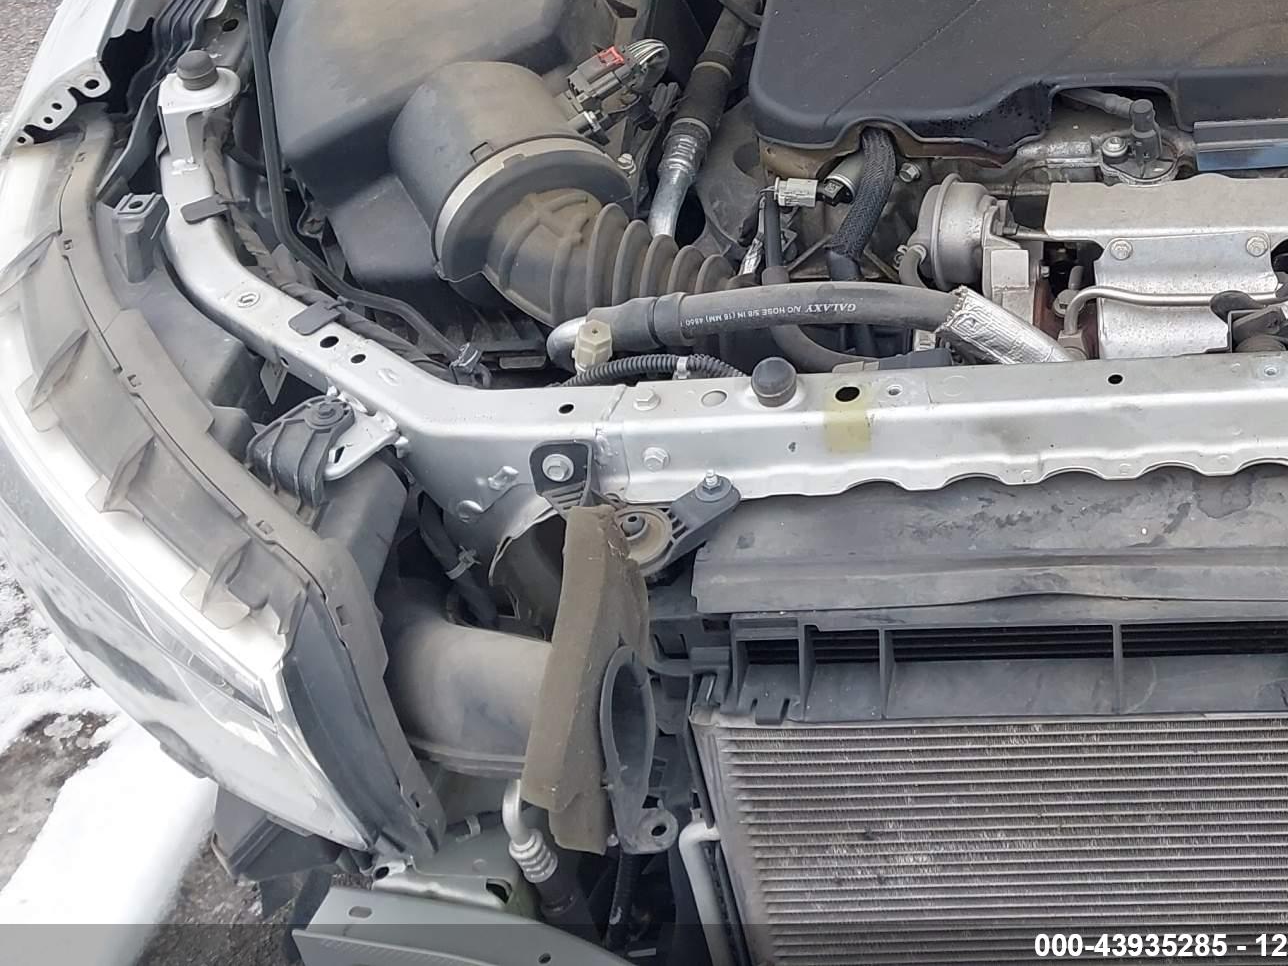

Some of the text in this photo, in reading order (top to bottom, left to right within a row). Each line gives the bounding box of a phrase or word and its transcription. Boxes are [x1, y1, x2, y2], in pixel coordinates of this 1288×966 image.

[762, 306, 785, 316] HOSE
[784, 305, 801, 314] A/C
[805, 303, 857, 313] GALAXY
[705, 313, 723, 324] MM)
[737, 310, 746, 319] IN
